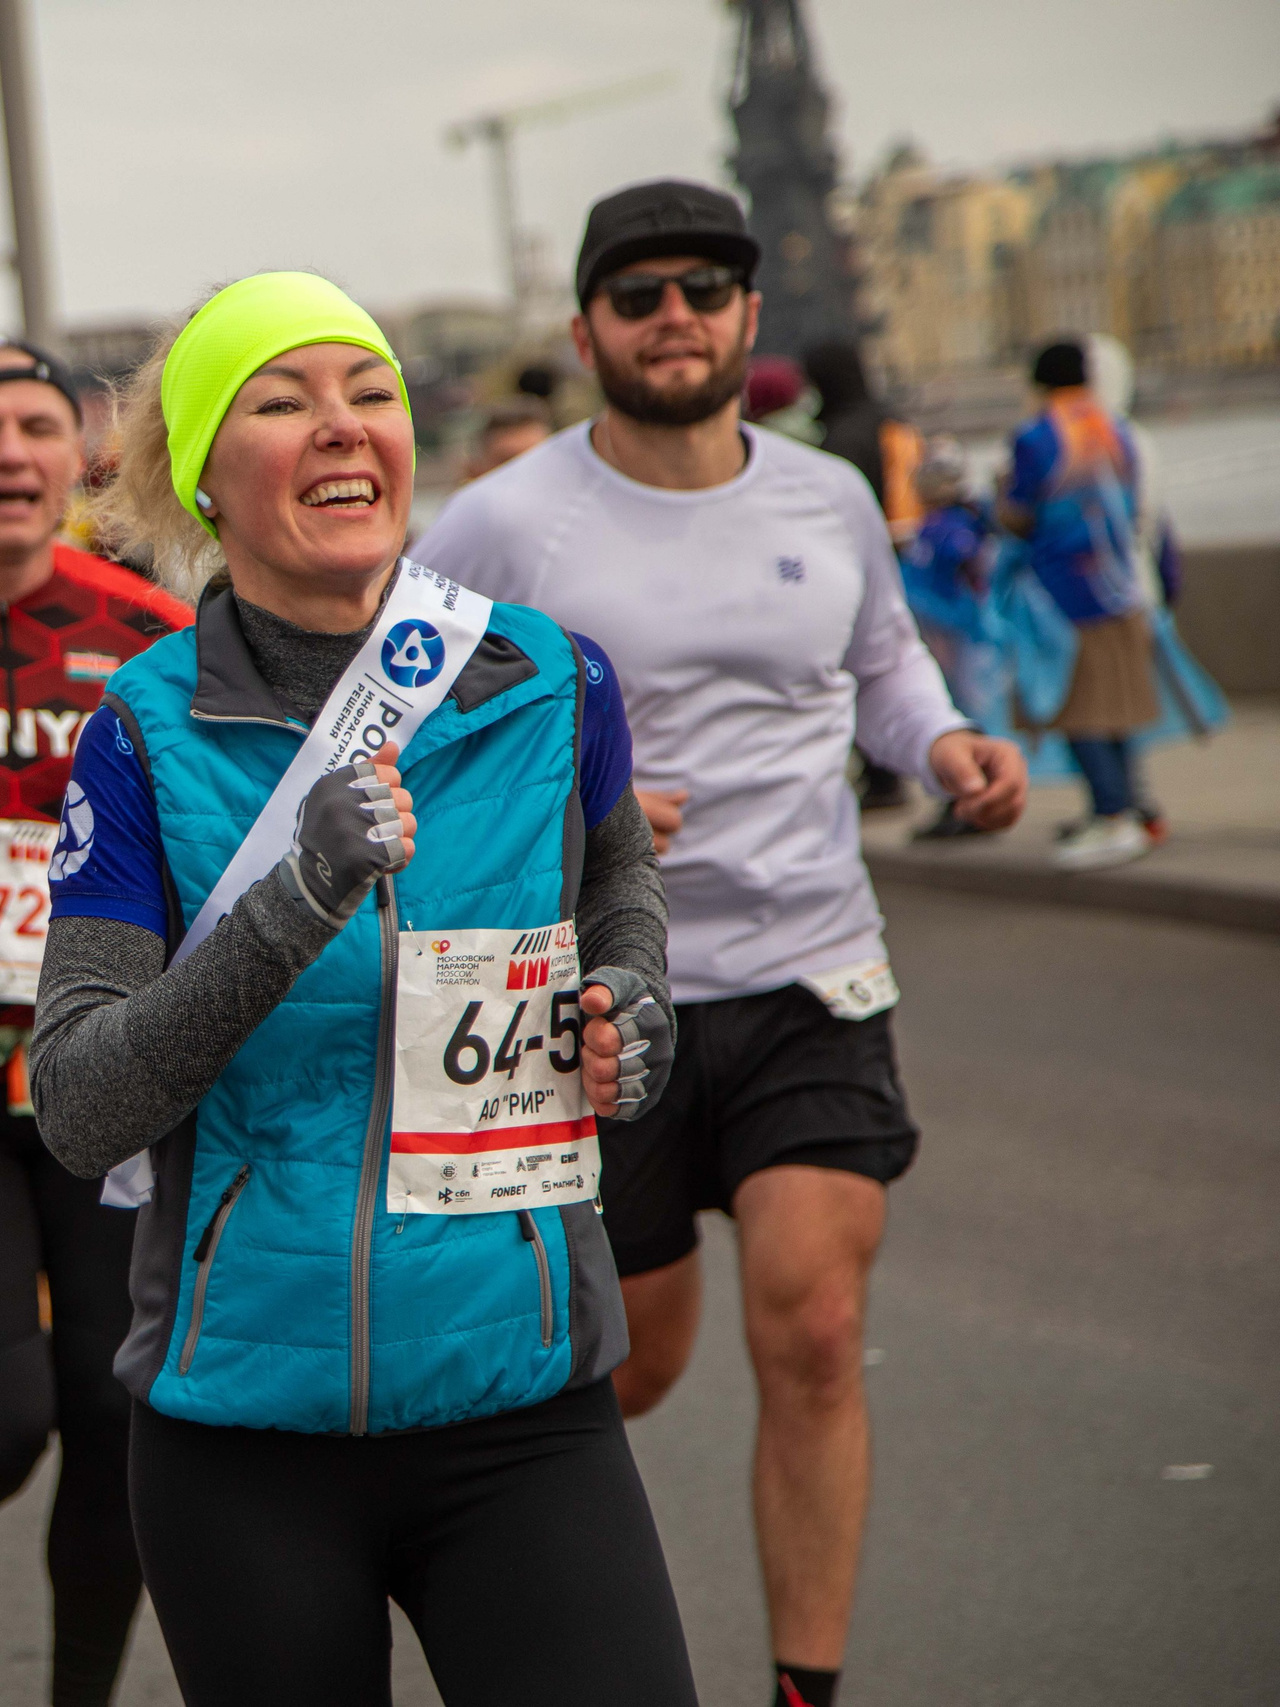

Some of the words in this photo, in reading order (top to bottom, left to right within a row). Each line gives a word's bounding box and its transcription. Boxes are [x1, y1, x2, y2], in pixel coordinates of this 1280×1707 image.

[329, 682, 366, 739] РЕШЕНИЯ
[322, 690, 376, 777] ИНФРАСТРУКТ
[437, 955, 495, 963] МОСКОВСКИЙ
[436, 970, 475, 978] MOSCOW
[479, 1098, 500, 1121] АО
[503, 1089, 554, 1116] "РИР"
[491, 1184, 528, 1199] FONBET
[553, 1179, 576, 1189] МАГНИТ
